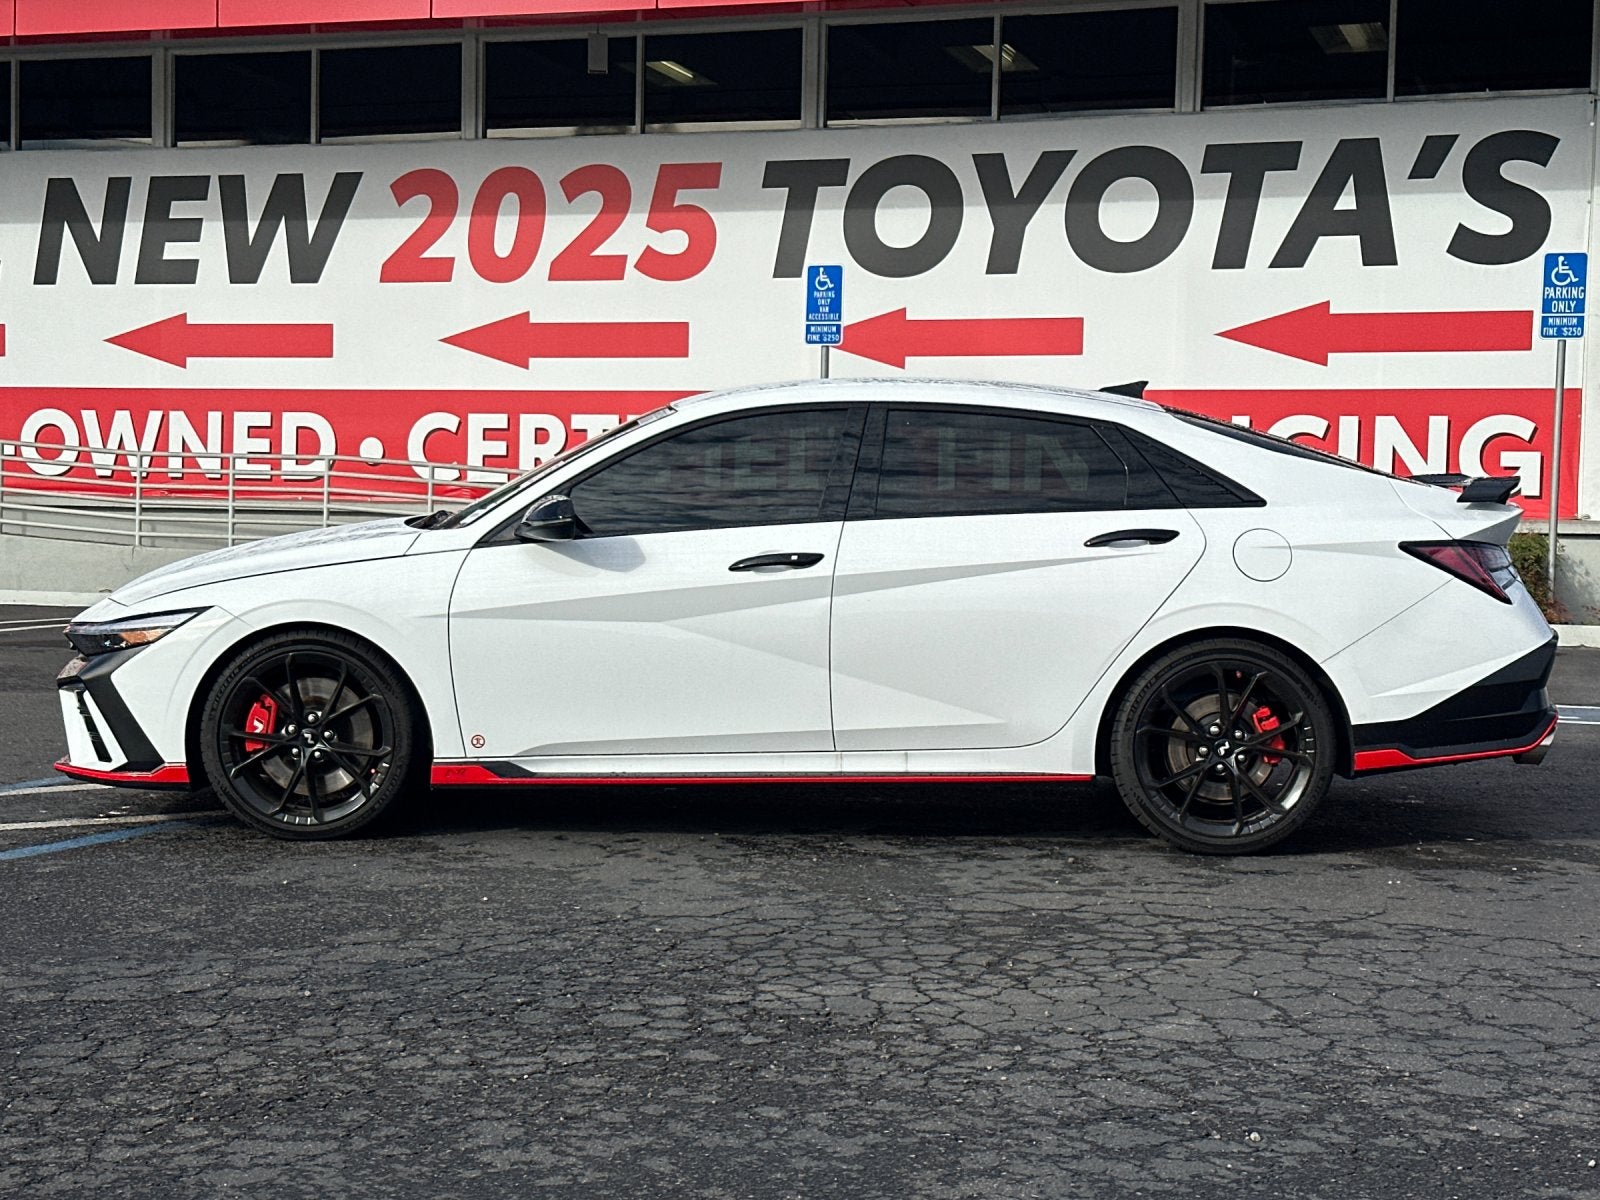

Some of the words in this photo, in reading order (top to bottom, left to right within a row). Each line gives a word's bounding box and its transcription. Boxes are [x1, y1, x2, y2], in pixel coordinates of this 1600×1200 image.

[33, 171, 364, 286] NEW
[379, 161, 723, 284] 2025
[762, 130, 1560, 279] TOYOTA'S
[1544, 287, 1584, 299] PARKING
[1551, 300, 1576, 313] ONLY
[1548, 317, 1578, 326] MINIMUM
[810, 325, 837, 333] MINIMUM
[1543, 327, 1558, 336] FINE
[1562, 327, 1582, 336] $250
[807, 334, 820, 342] FINE
[822, 334, 840, 342] $250
